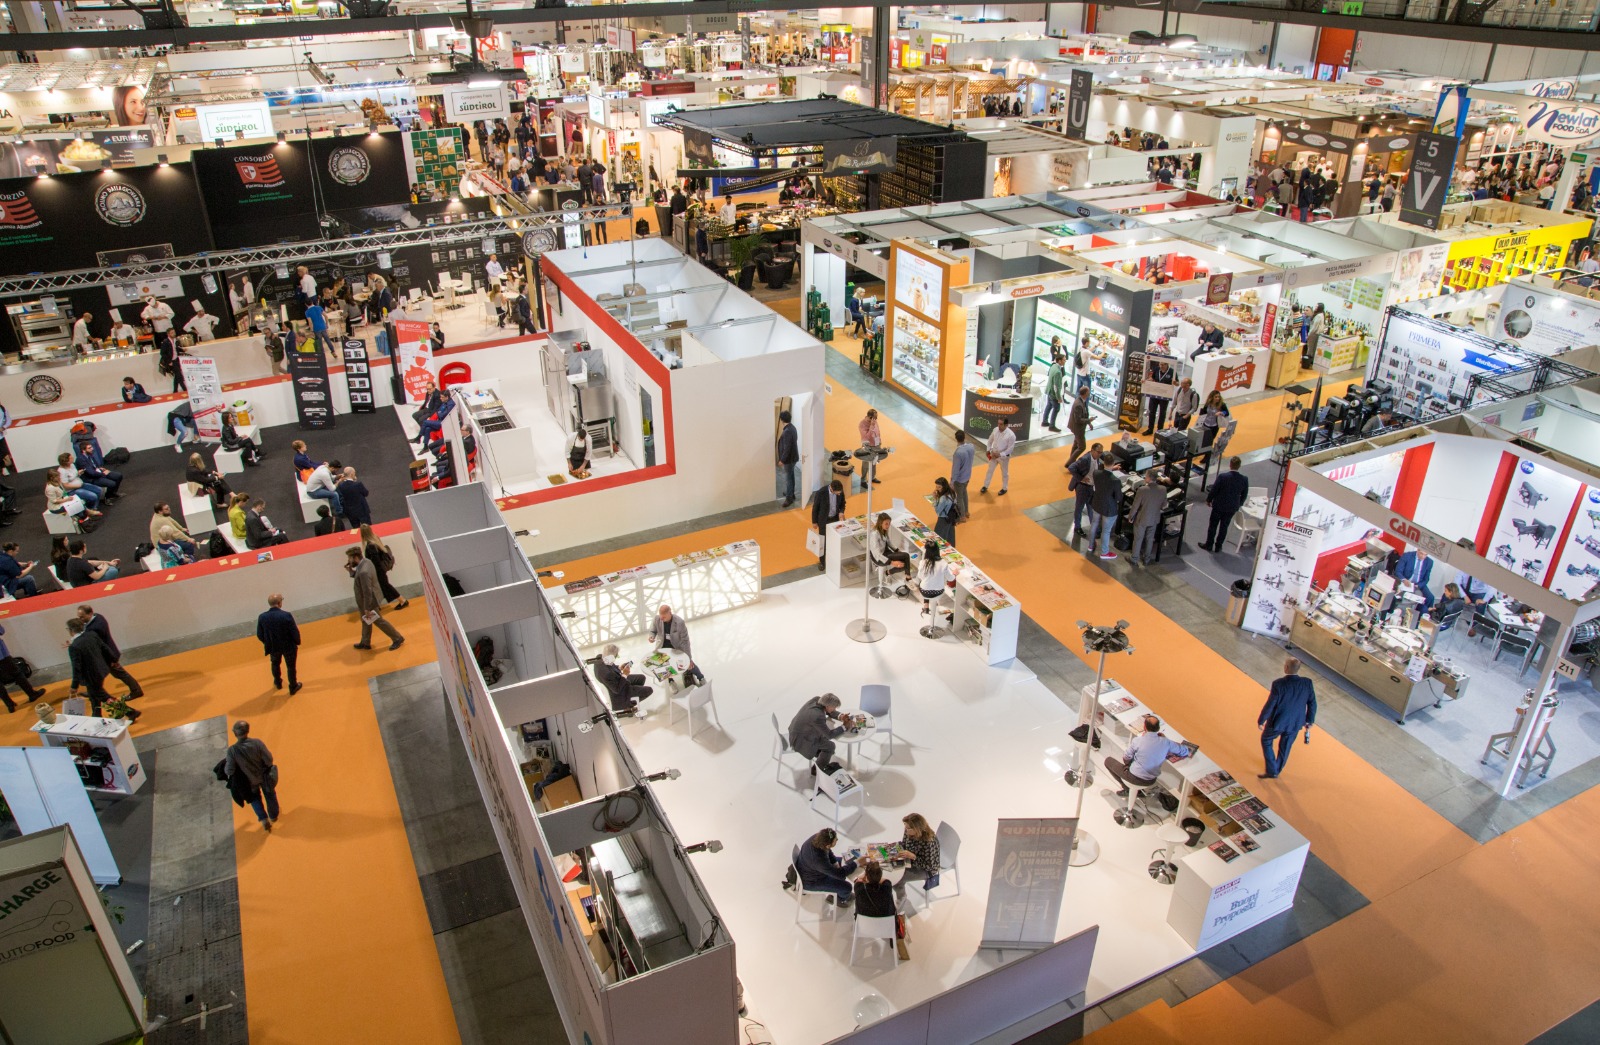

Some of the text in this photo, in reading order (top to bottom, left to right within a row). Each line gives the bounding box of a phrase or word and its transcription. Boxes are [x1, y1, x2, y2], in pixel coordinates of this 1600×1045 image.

[742, 36, 749, 54] S
[1343, 50, 1351, 65] 5
[863, 58, 872, 80] T
[1077, 76, 1083, 88] 5
[1071, 98, 1086, 128] U
[1552, 123, 1574, 132] FOOD
[1427, 141, 1439, 157] 5
[233, 153, 274, 163] CONSORZIO
[1416, 159, 1431, 167] Corsia
[1413, 170, 1442, 210] V
[1498, 235, 1528, 248] OLIO DANTE
[1015, 287, 1041, 296] PALMISANO
[1408, 331, 1441, 349] PRIMERA
[1220, 372, 1248, 389] CASA
[979, 402, 1013, 413] PALMISANO
[1123, 397, 1139, 407] PRO
[1558, 662, 1575, 676] Z11
[1230, 889, 1260, 911] Buoni
